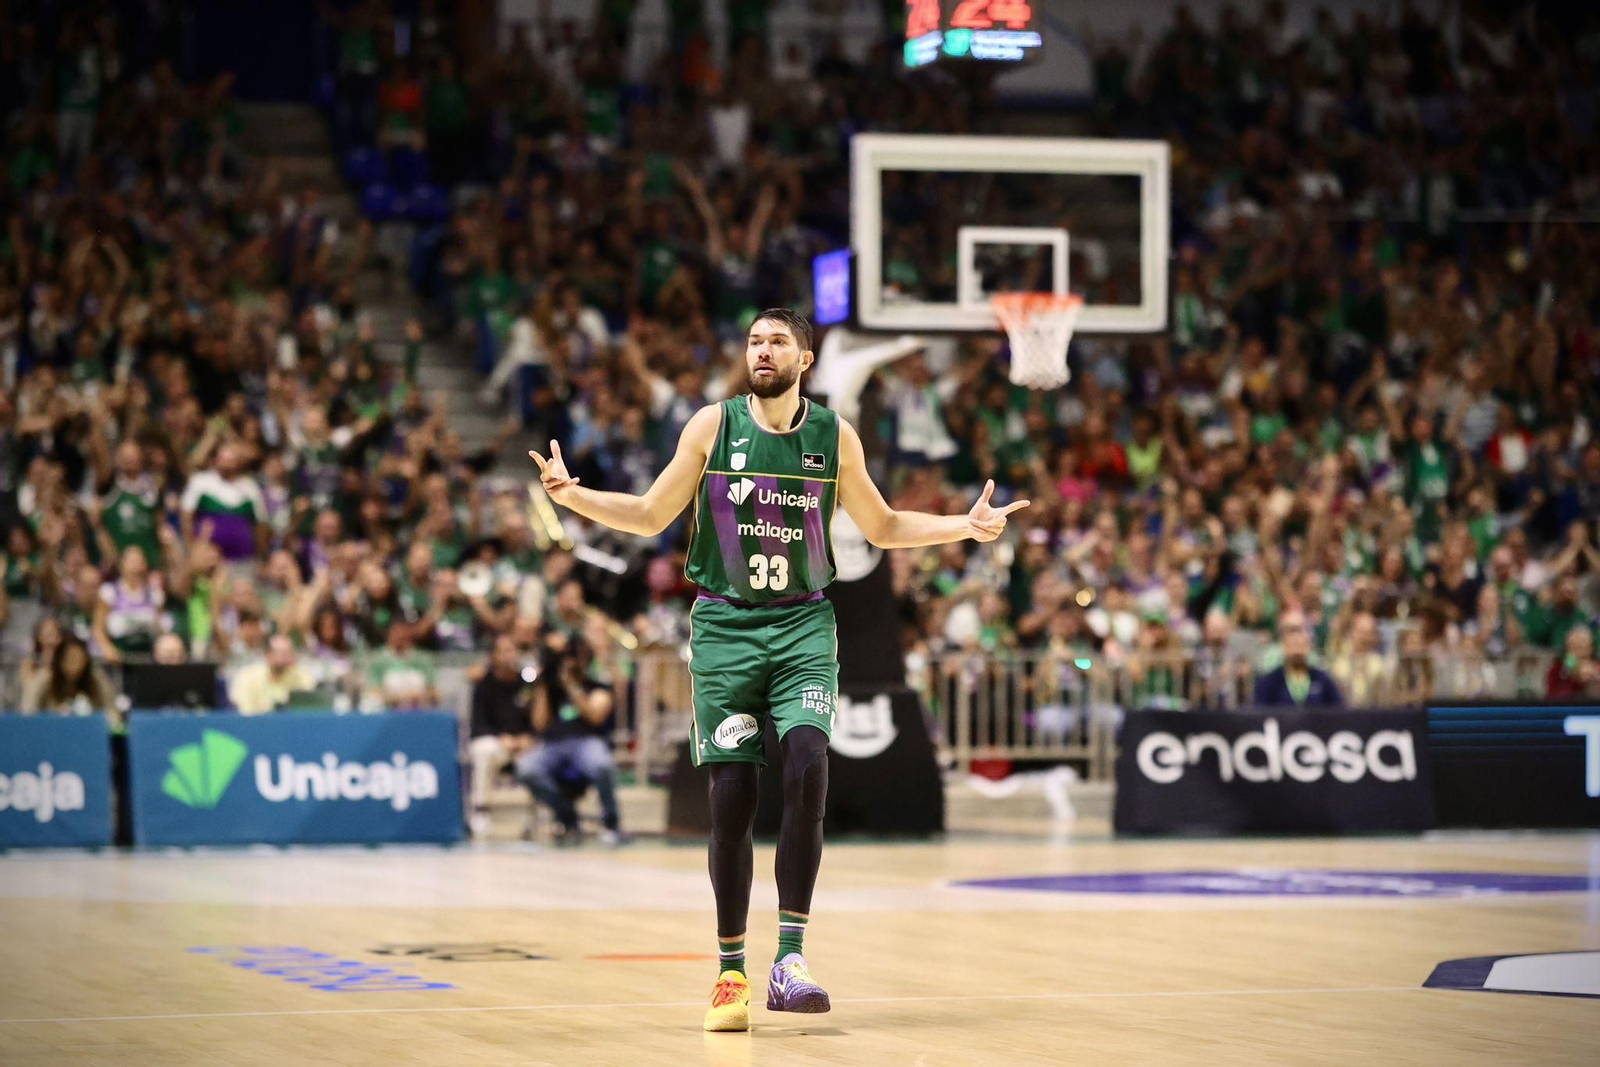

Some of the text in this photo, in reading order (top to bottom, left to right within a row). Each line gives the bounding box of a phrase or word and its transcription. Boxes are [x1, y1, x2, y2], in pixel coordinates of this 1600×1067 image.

[758, 488, 819, 512] Unicaja
[749, 553, 789, 591] 33
[1136, 717, 1417, 784] endesa
[254, 751, 439, 812] Unicaja
